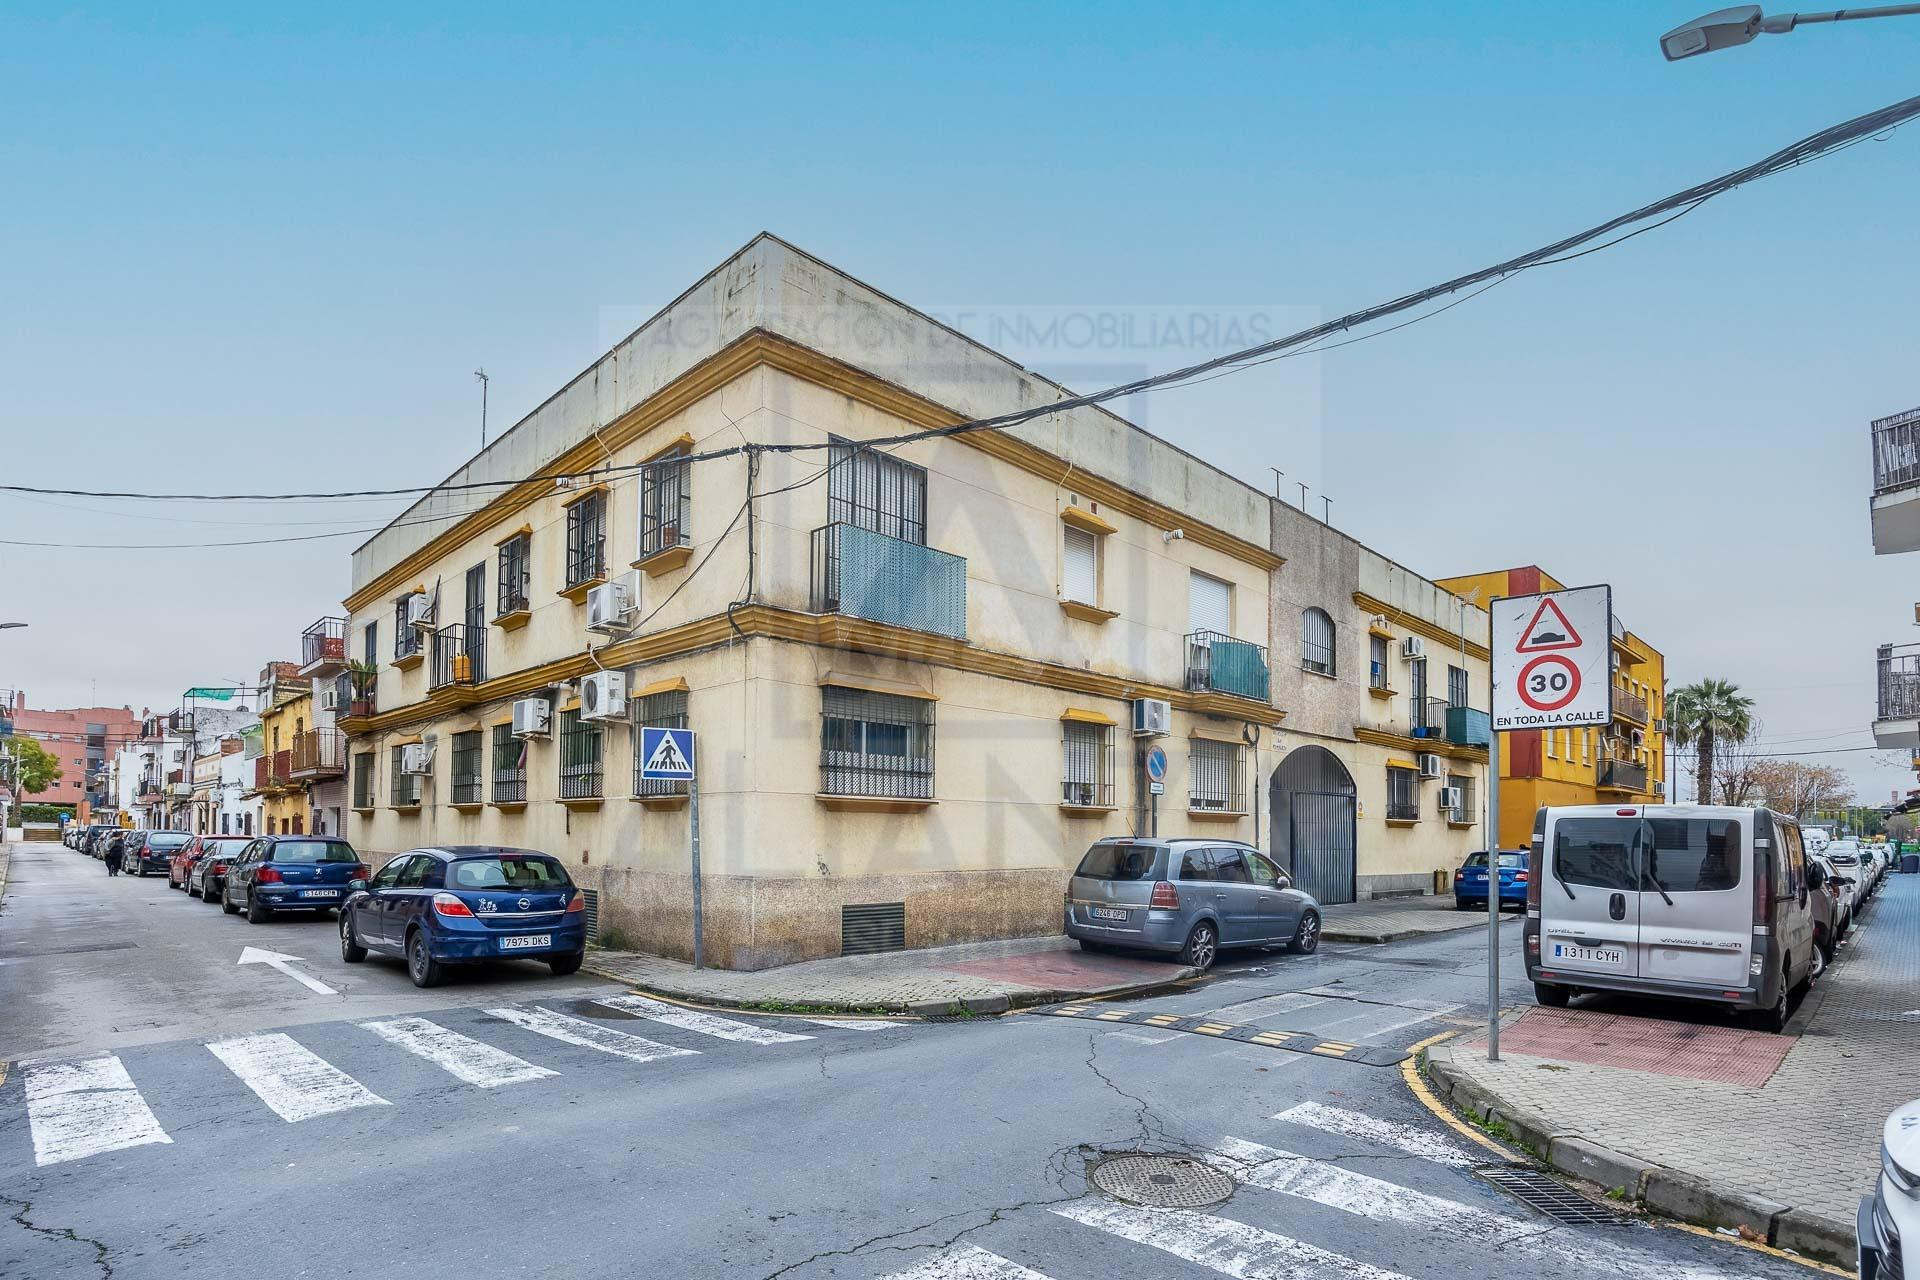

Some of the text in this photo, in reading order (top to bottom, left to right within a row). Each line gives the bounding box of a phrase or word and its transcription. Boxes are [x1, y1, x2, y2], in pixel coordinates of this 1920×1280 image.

[1530, 672, 1567, 693] 30
[1497, 710, 1604, 726] EN TODA LA CALLE
[506, 936, 549, 947] 7975 DKS
[1564, 947, 1619, 962] 1311 CYH
